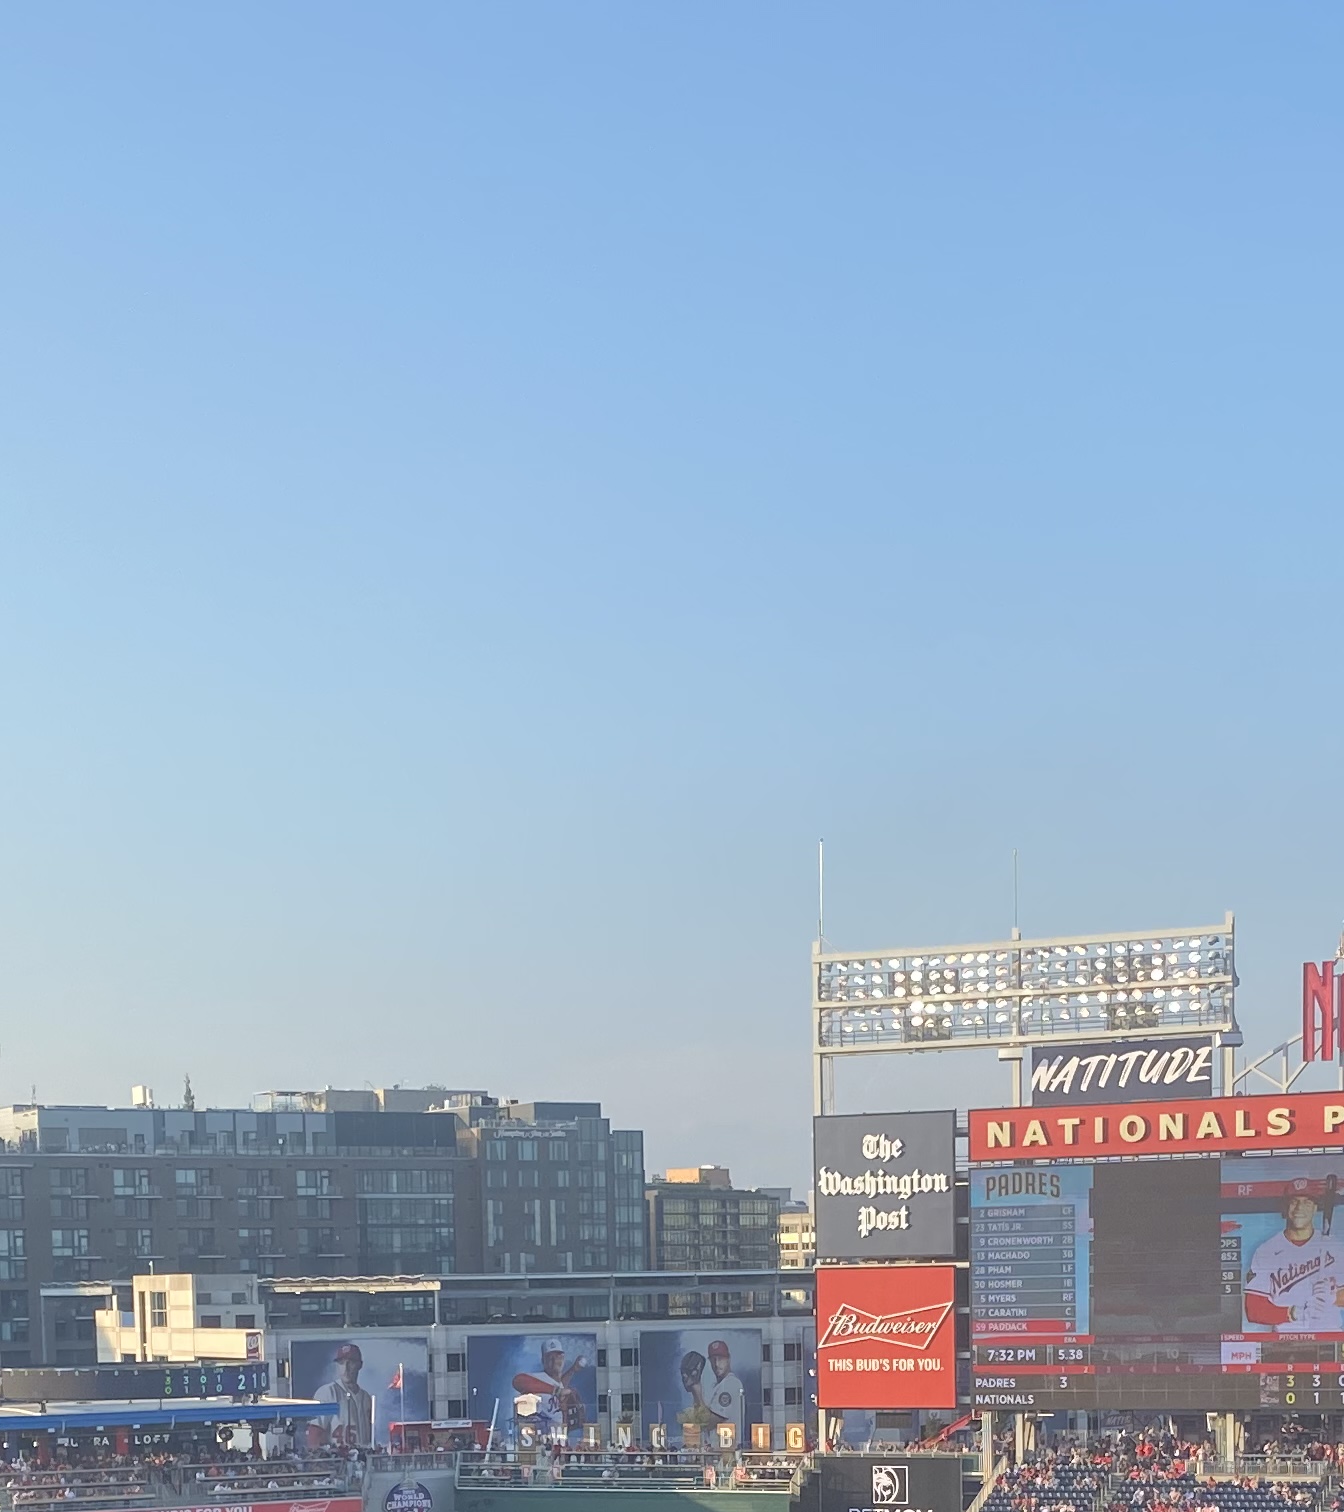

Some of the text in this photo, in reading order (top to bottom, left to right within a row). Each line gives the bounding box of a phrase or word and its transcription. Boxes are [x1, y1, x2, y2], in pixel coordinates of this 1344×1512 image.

[1031, 1046, 1212, 1094] NATITUDE
[987, 1107, 1293, 1148] NATIONALS
[862, 1134, 903, 1161] The
[818, 1166, 949, 1200] Washington
[985, 1172, 1061, 1201] PADRES
[1238, 1185, 1253, 1196] RF
[858, 1205, 909, 1238] Post
[829, 1308, 939, 1337] Budweiser
[987, 1348, 1036, 1362] 7:32 PM
[1058, 1349, 1084, 1361] 5.38
[828, 1358, 854, 1372] THIS
[856, 1358, 890, 1371] BUD'S
[892, 1358, 915, 1371] FOR
[238, 1374, 246, 1390] 2
[975, 1376, 1067, 1389] PADRES 3
[1287, 1375, 1295, 1387] 3
[1312, 1375, 1321, 1387] 3
[975, 1393, 1034, 1405] NATIONALS
[1286, 1392, 1295, 1404] 0
